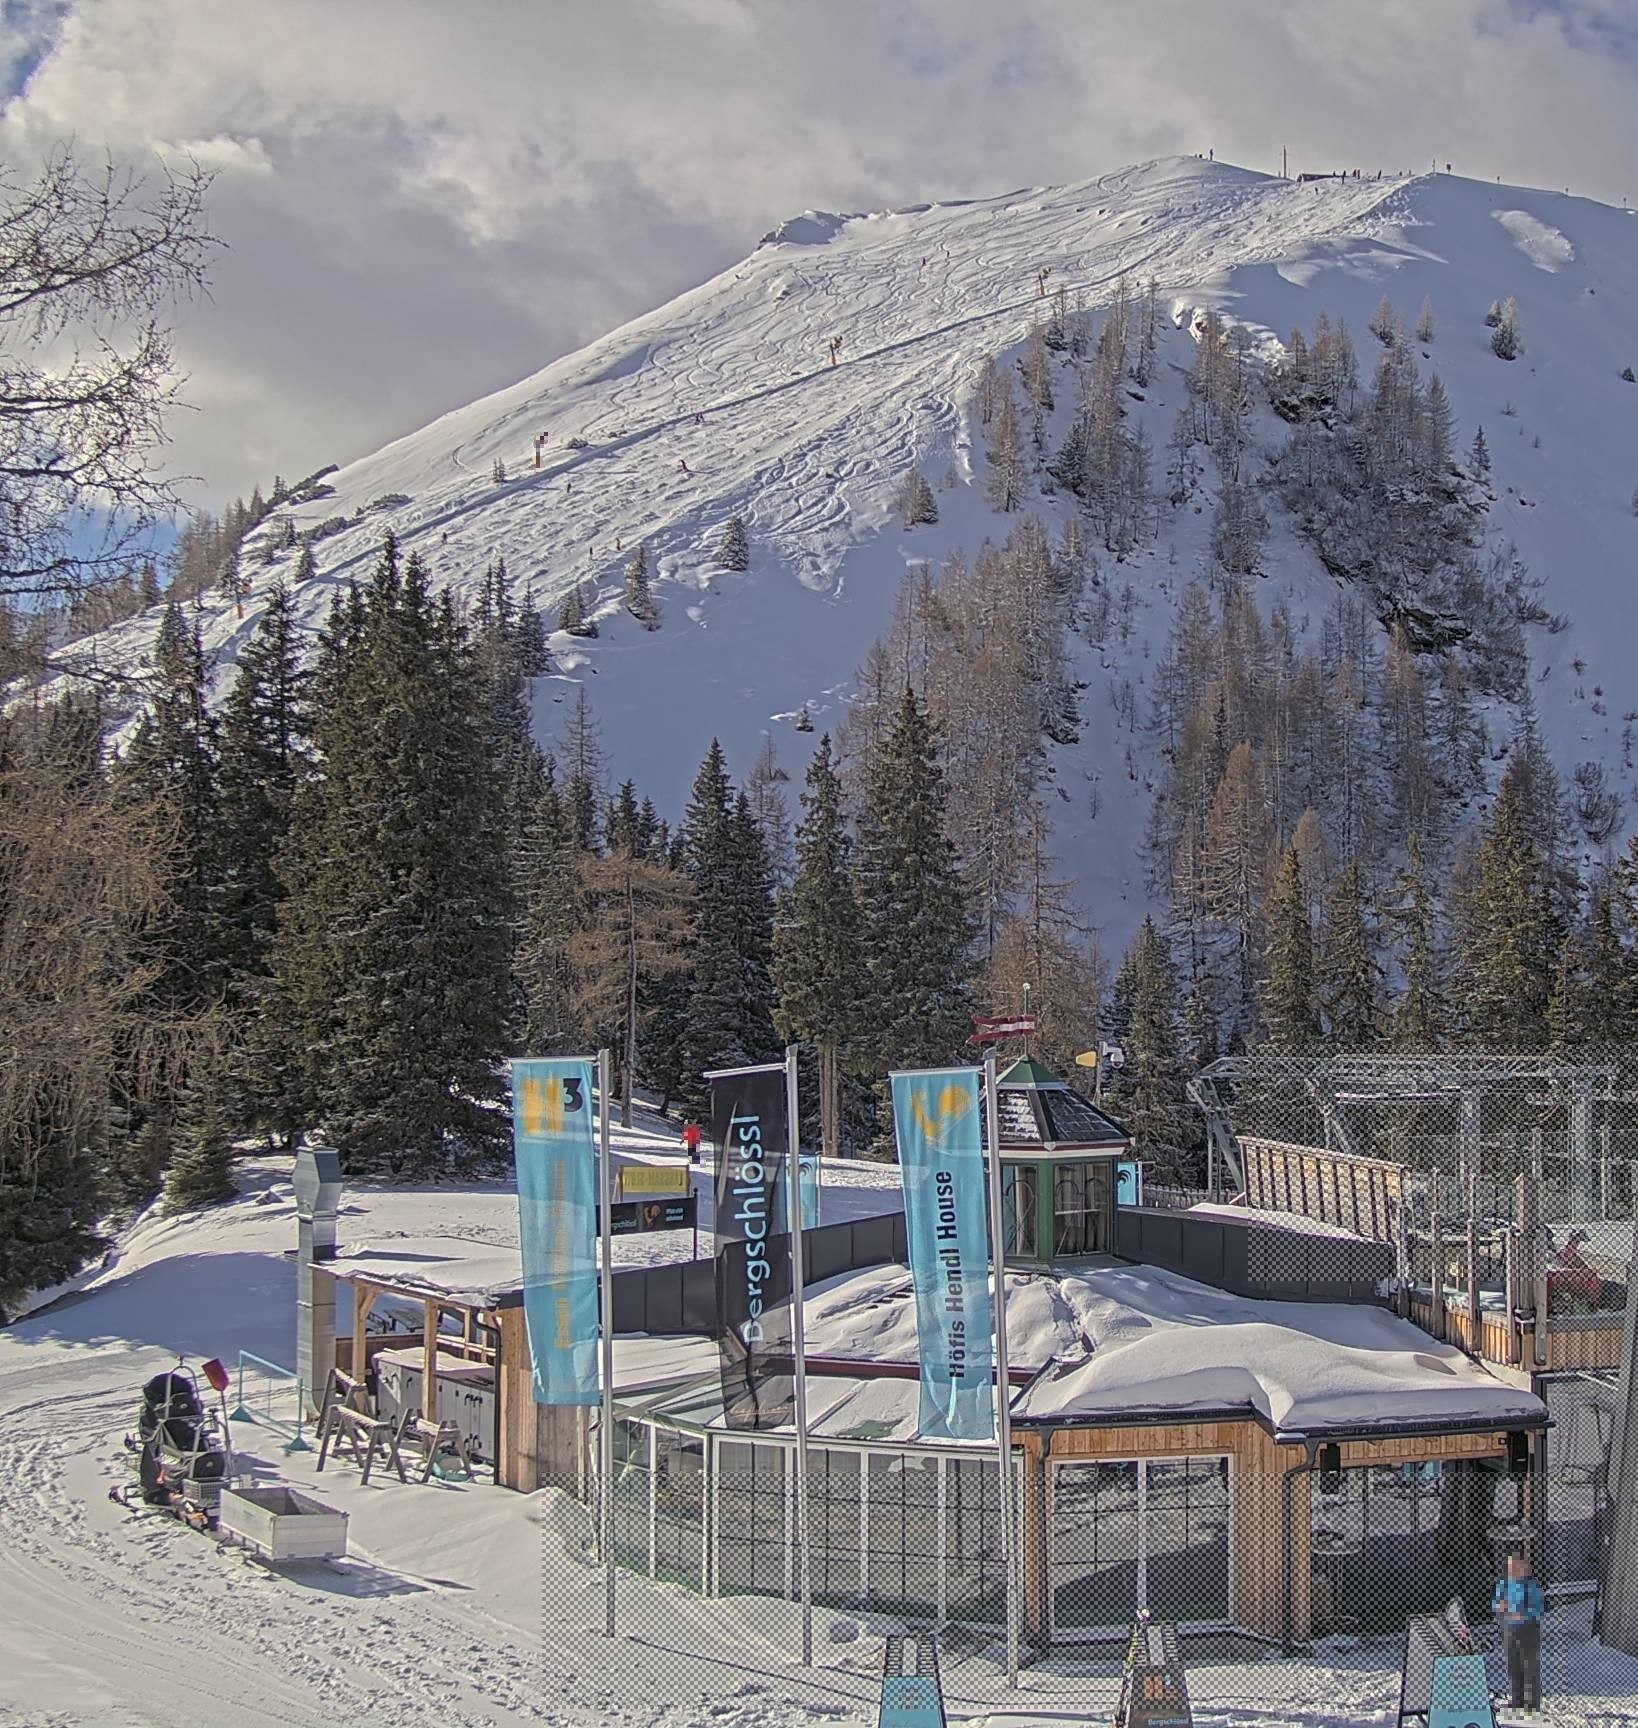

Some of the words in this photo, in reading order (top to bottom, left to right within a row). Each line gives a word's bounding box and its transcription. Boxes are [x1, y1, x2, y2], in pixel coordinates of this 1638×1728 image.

[730, 1114, 771, 1345] Bergschlössl
[936, 1171, 959, 1240] House
[939, 1248, 965, 1312] Hendl
[948, 1320, 966, 1378] Höfis
